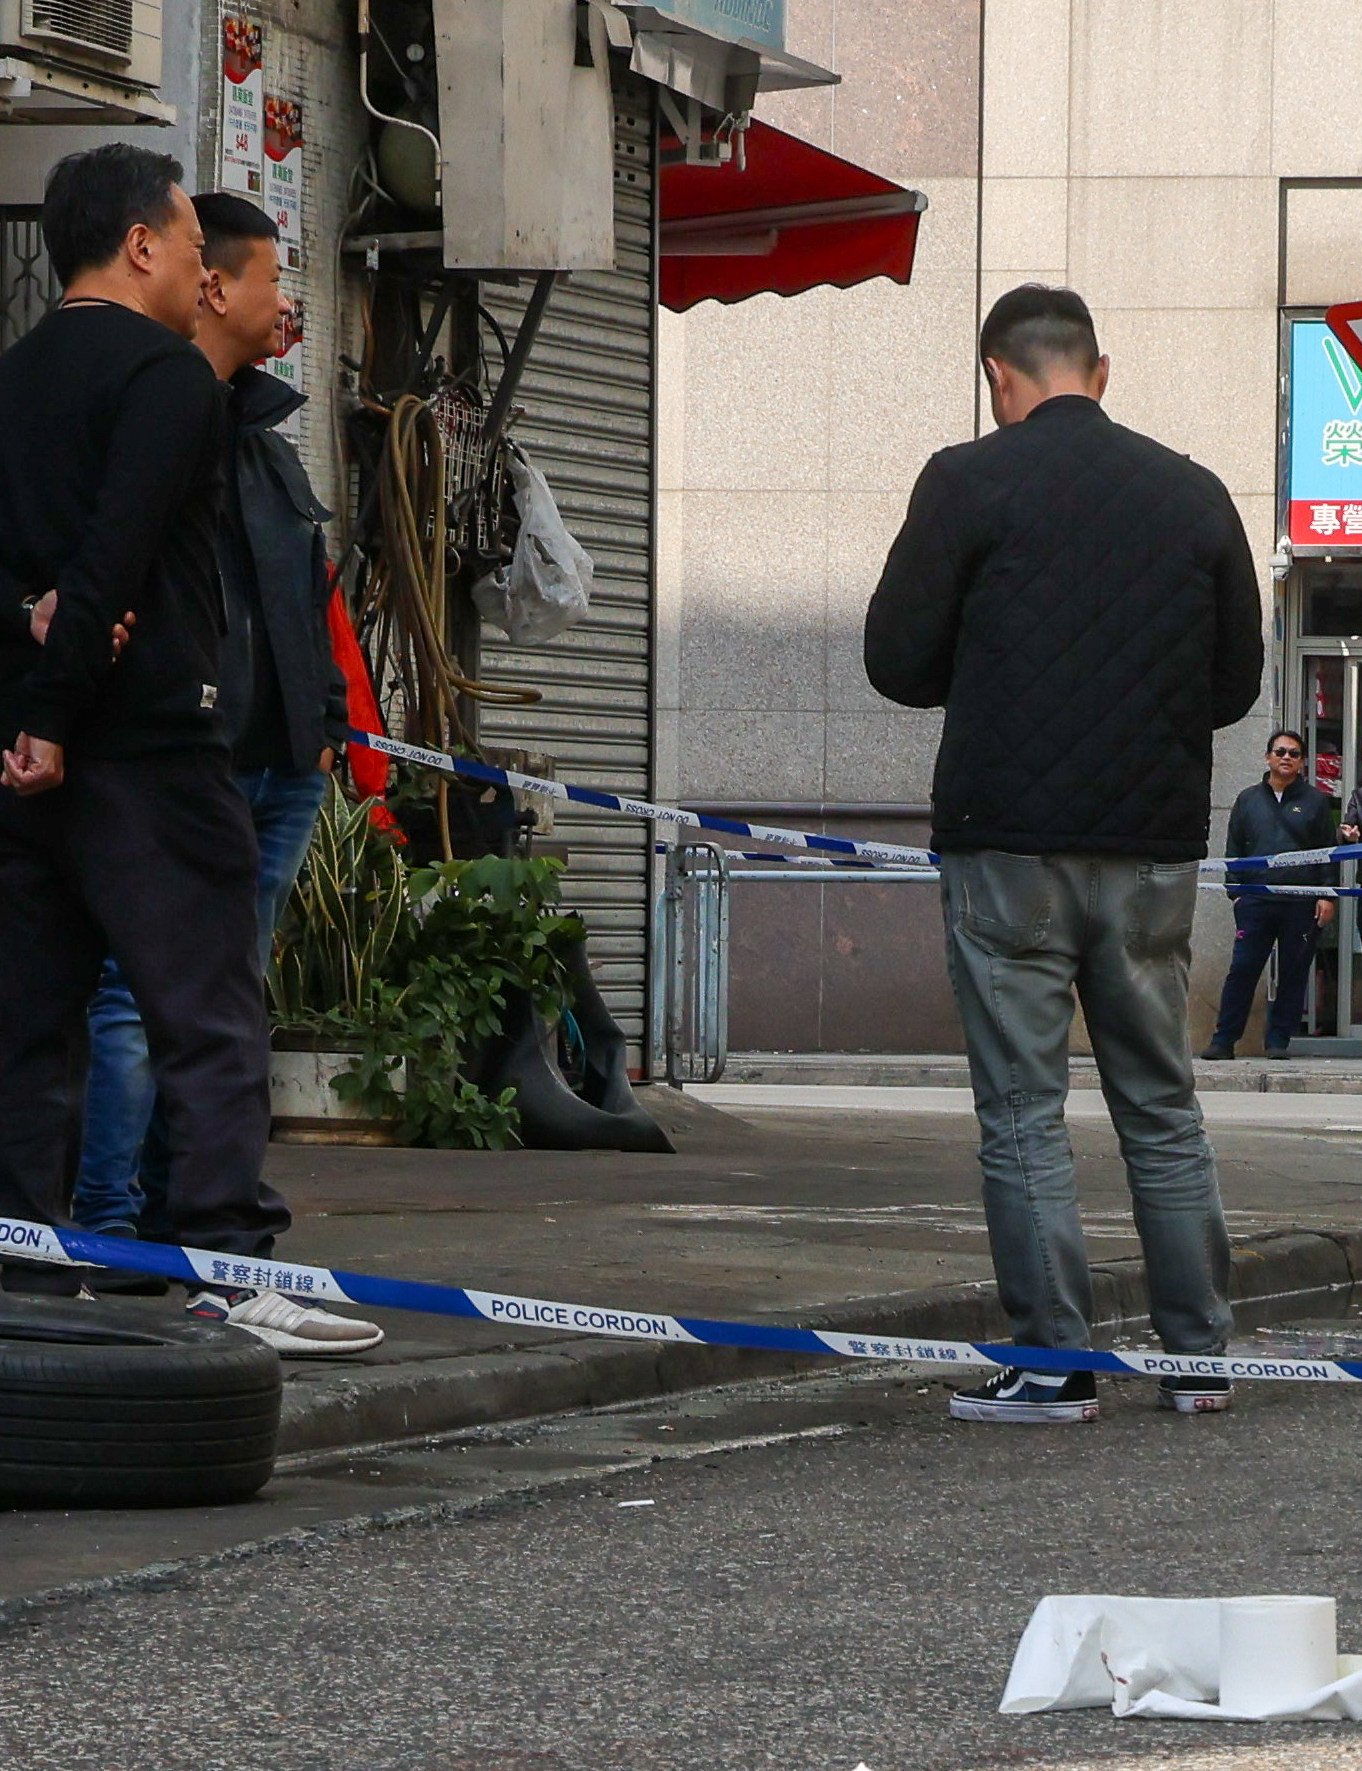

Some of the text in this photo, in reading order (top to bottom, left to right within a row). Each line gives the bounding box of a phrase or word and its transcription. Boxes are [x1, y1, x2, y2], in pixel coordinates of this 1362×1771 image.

[408, 750, 429, 764] NOT
[428, 755, 443, 766] DO
[492, 1299, 569, 1325] POLICE
[1144, 1358, 1226, 1375] POLICE
